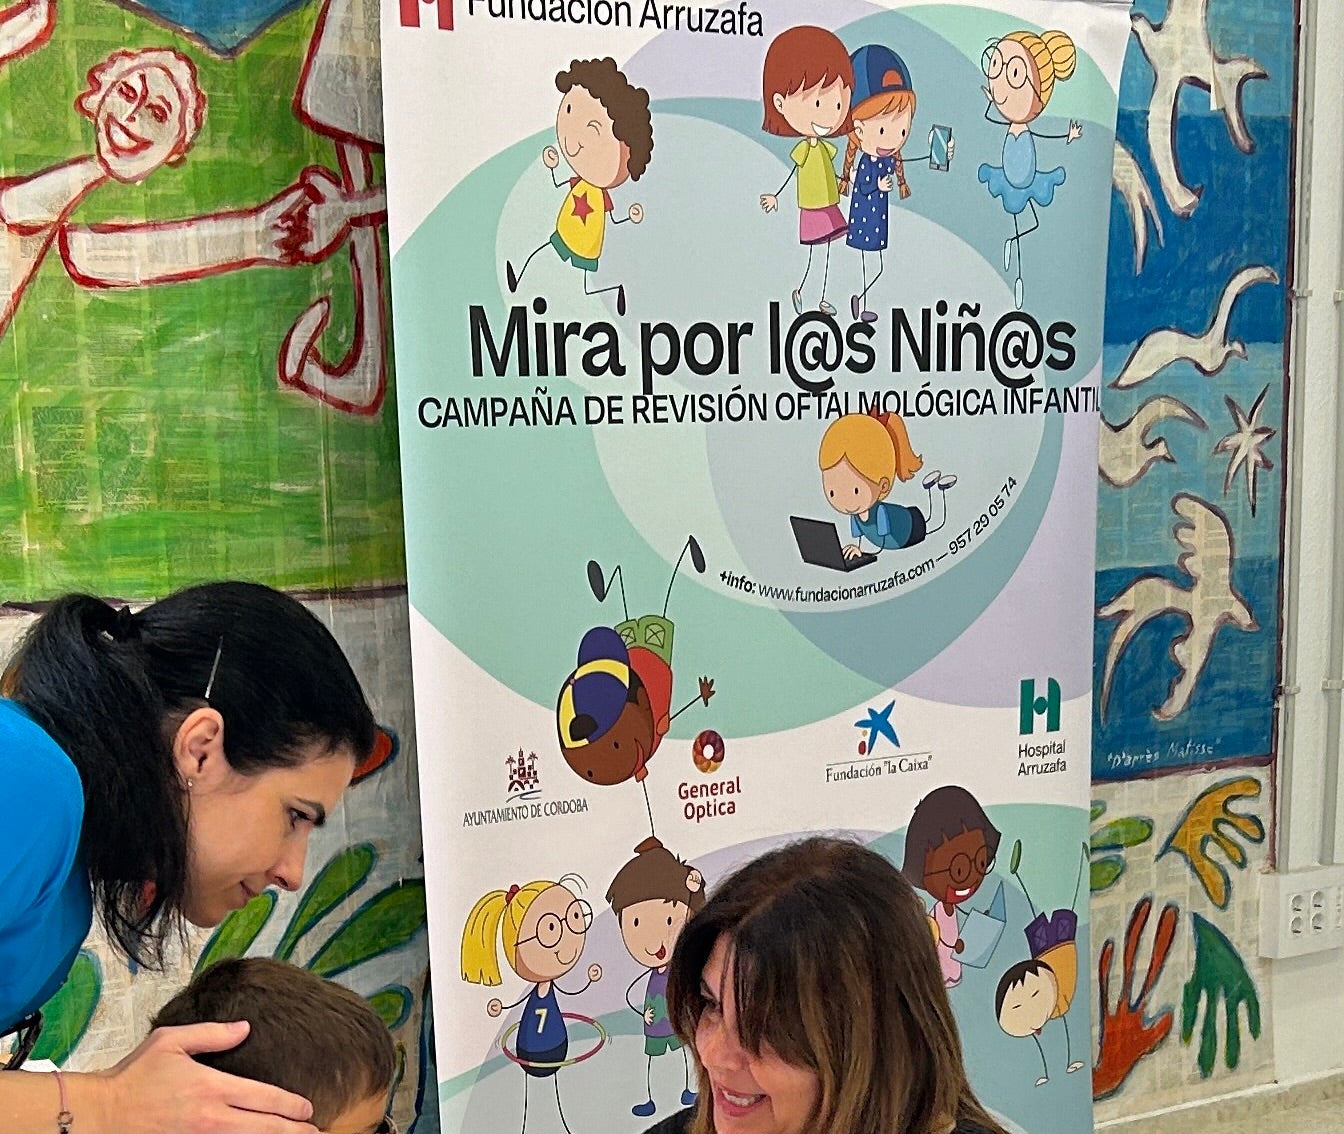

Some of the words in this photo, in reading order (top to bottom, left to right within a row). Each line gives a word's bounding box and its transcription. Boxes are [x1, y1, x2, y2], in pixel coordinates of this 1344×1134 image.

[639, 0, 765, 37] Arruzafa
[469, 296, 627, 377] Mira
[641, 321, 754, 395] por
[769, 301, 877, 393] l@s
[891, 299, 1077, 388] Niñ@s
[418, 386, 577, 429] CAMPAÑA
[584, 395, 625, 426] DE
[632, 384, 768, 425] REVISIÓN
[775, 381, 998, 421] OFTALMOLÓGICA
[1003, 386, 1100, 416] INFANTIL
[949, 528, 972, 555] 957
[973, 513, 990, 535] 29
[988, 495, 1005, 517] 05
[1000, 476, 1017, 497] 74
[720, 570, 757, 594] +info:
[758, 558, 935, 603] www.fundacionarruzafa.com
[1018, 739, 1067, 759] Hospital
[825, 763, 882, 783] Fundación
[1017, 757, 1067, 777] Arruzafa
[678, 775, 742, 801] General
[462, 804, 529, 828] AYUNTAMIENTO
[530, 803, 543, 819] DE
[683, 800, 737, 824] Optica
[535, 1008, 548, 1034] 7
